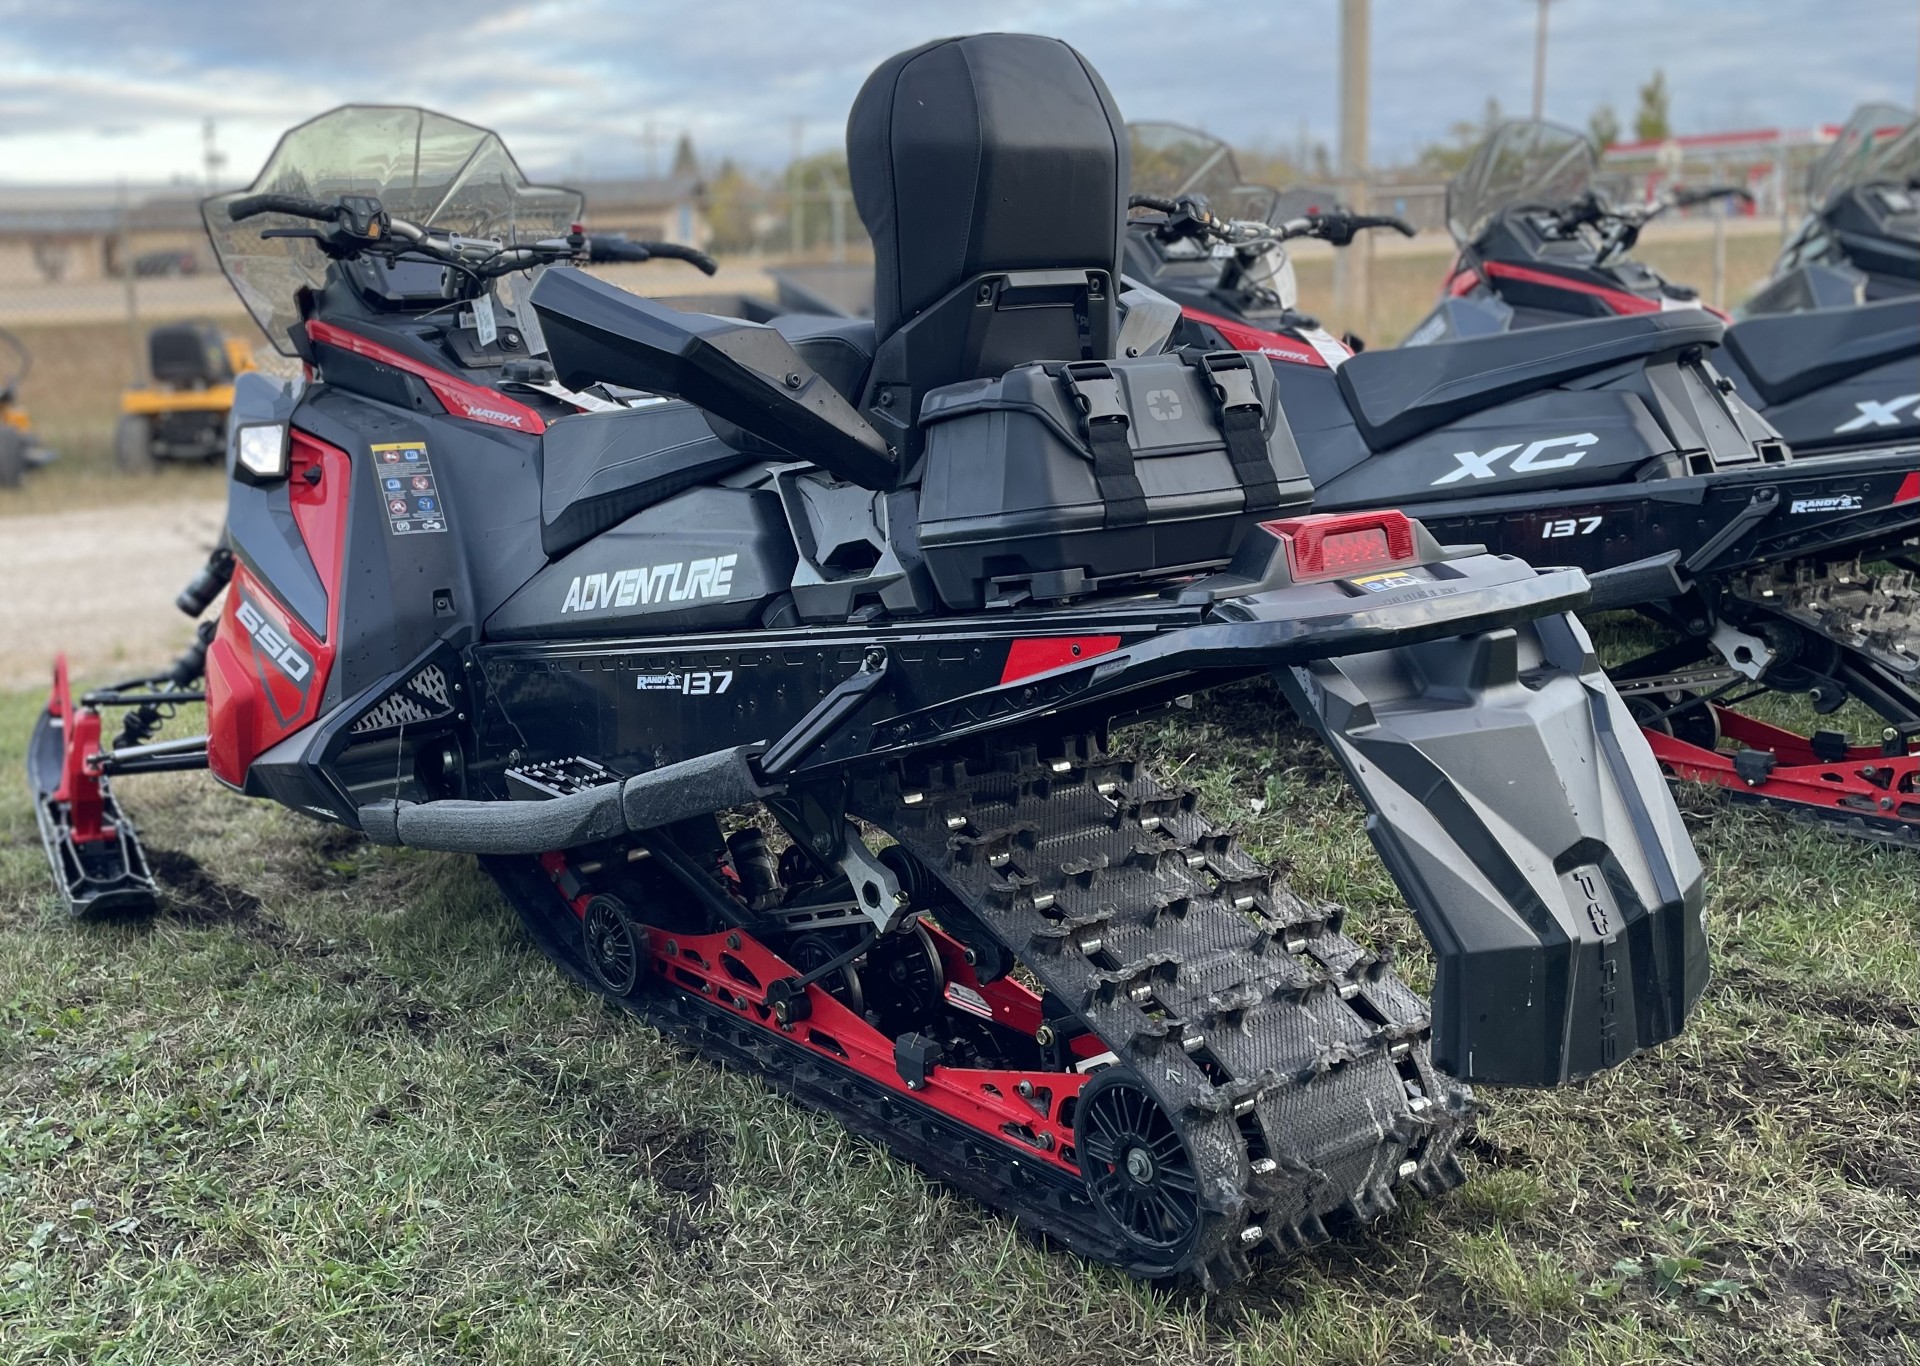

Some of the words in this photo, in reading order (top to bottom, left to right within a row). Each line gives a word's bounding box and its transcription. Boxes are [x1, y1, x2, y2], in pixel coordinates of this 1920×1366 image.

[467, 406, 521, 427] MATRYX
[1834, 393, 1920, 433] X
[1430, 432, 1599, 486] XC
[1542, 516, 1602, 539] 137
[560, 553, 738, 614] ADVENTURE
[235, 600, 310, 682] 650
[682, 670, 733, 695] 137
